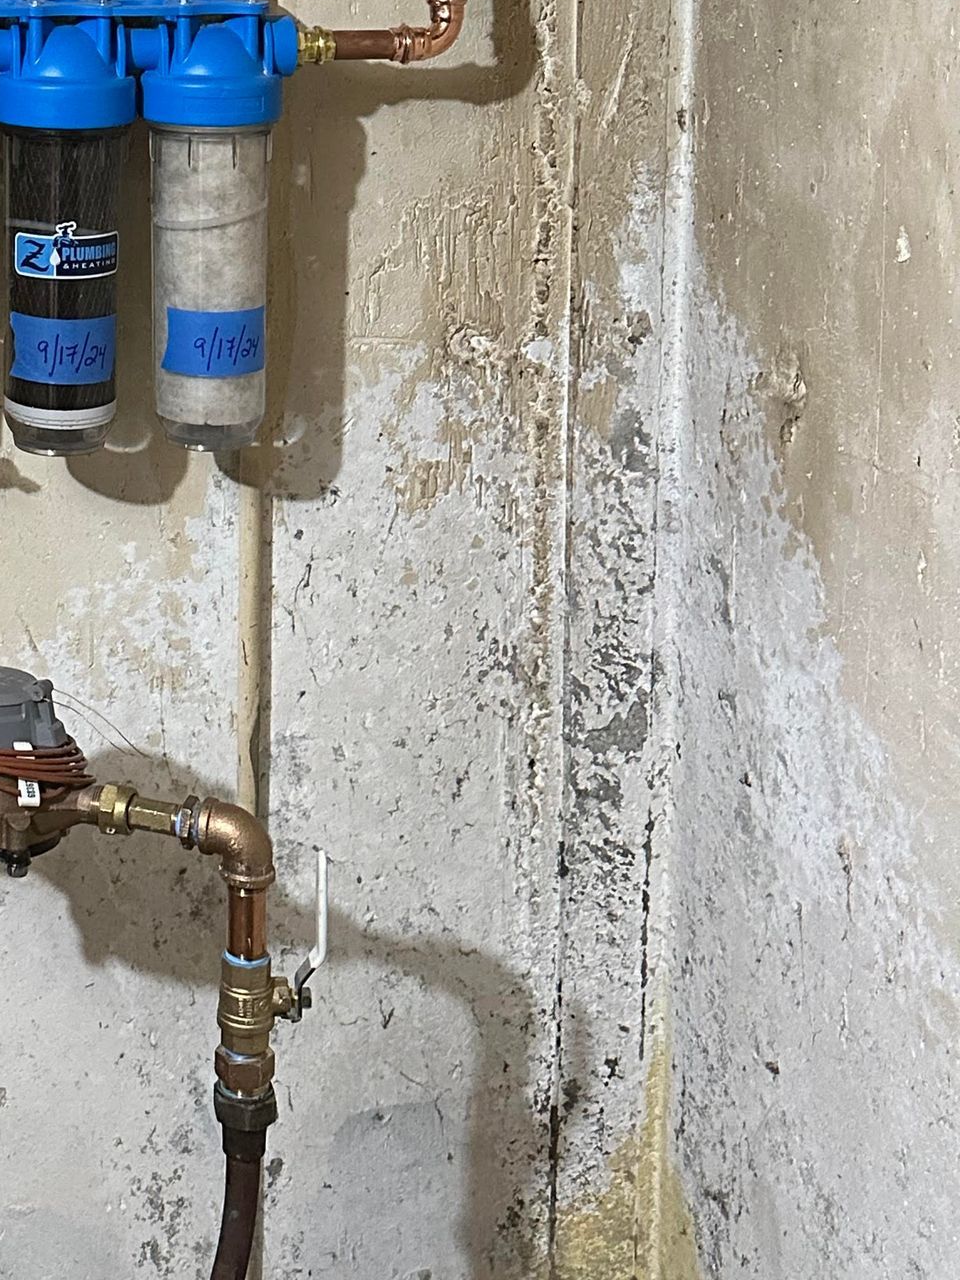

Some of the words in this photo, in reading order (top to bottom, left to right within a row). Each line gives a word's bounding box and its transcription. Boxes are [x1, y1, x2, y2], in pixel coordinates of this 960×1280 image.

[20, 239, 50, 272] Z
[61, 241, 116, 261] PLUMBING
[37, 330, 107, 377] 9/17/24
[192, 324, 260, 372] 9/17/24
